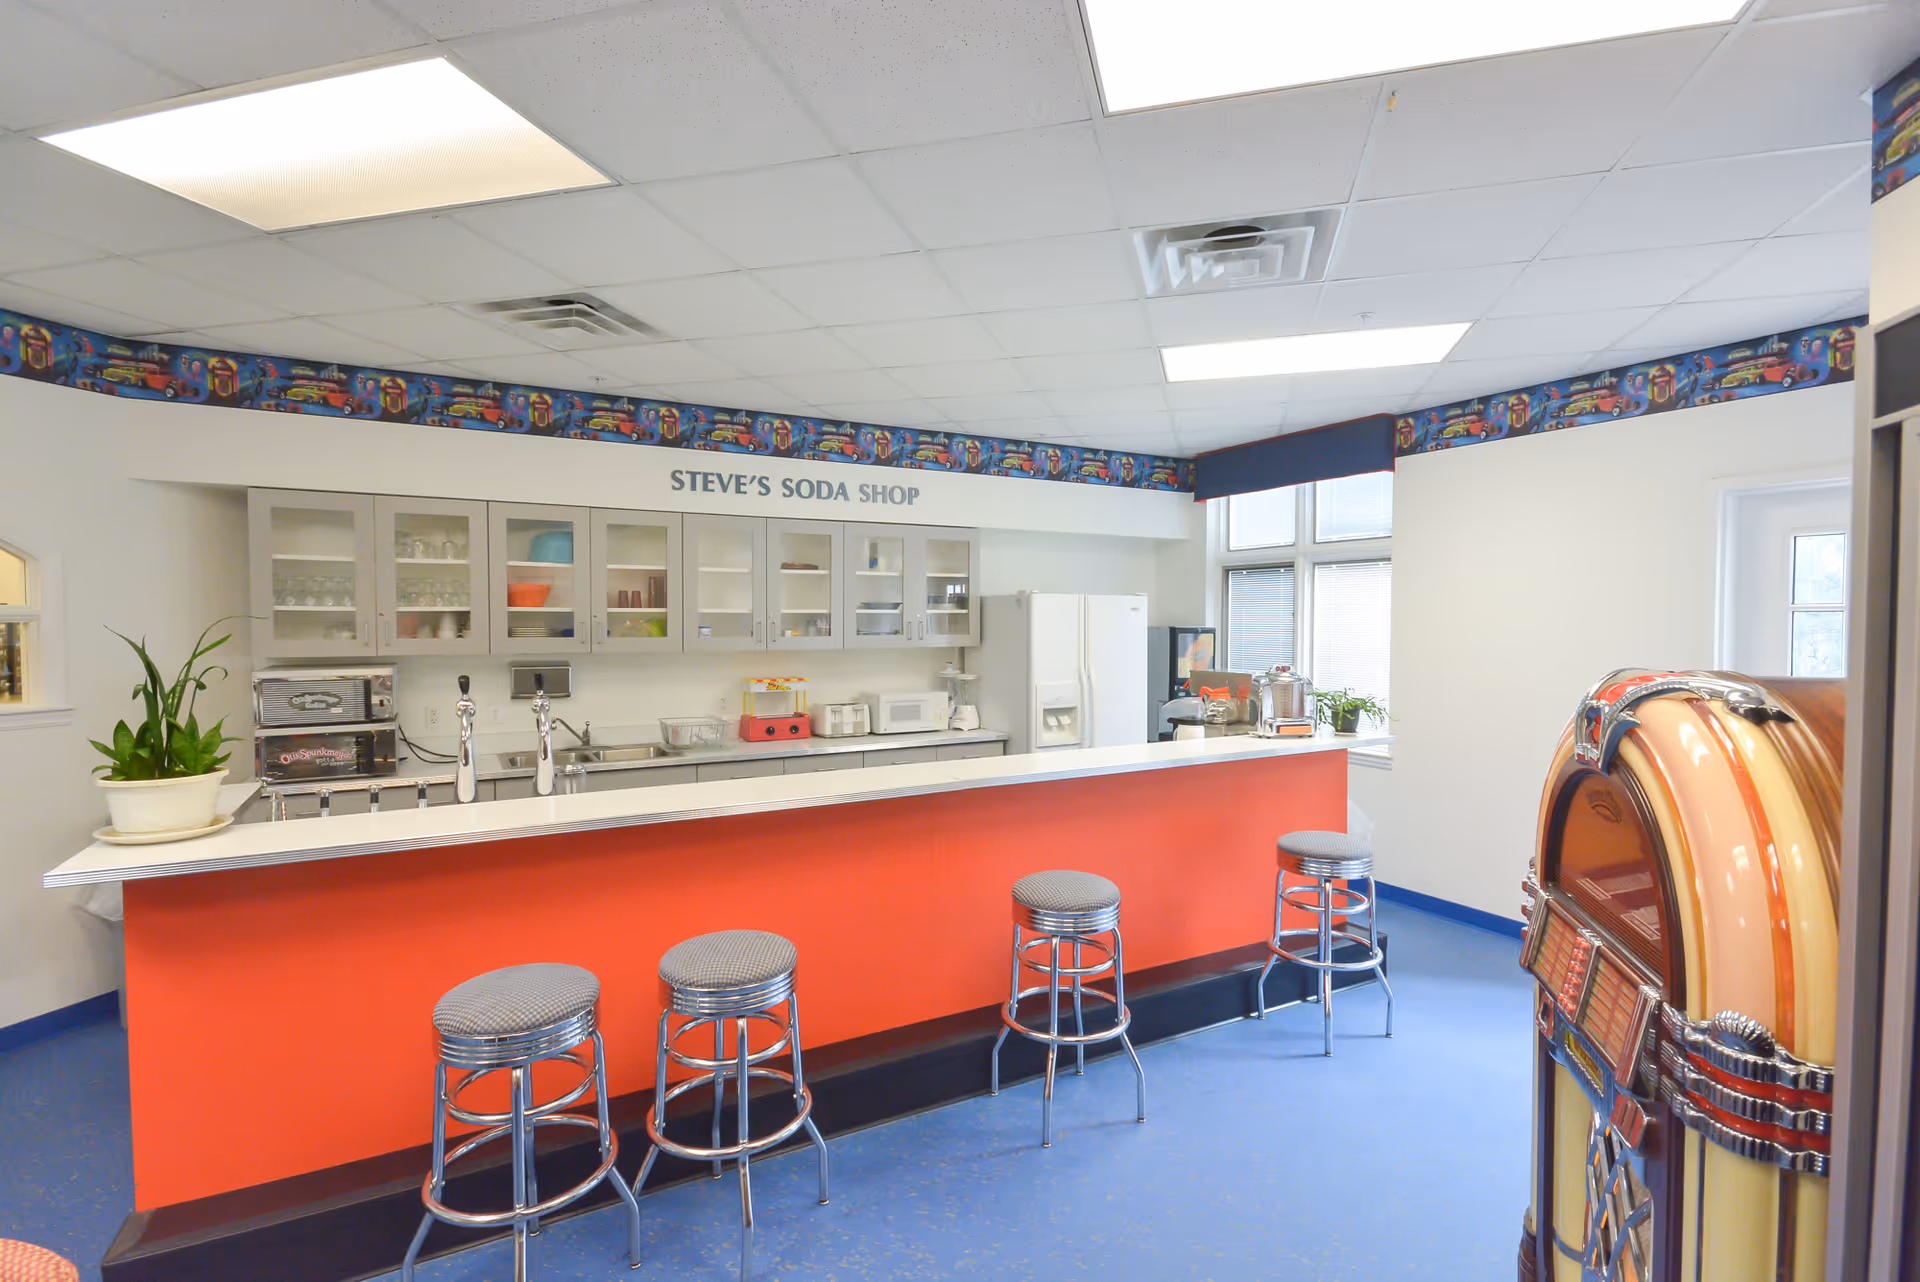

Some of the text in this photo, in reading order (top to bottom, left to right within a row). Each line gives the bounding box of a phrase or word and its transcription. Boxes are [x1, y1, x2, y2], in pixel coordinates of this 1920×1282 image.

[670, 470, 920, 505] STEVE'S SODA SHOP
